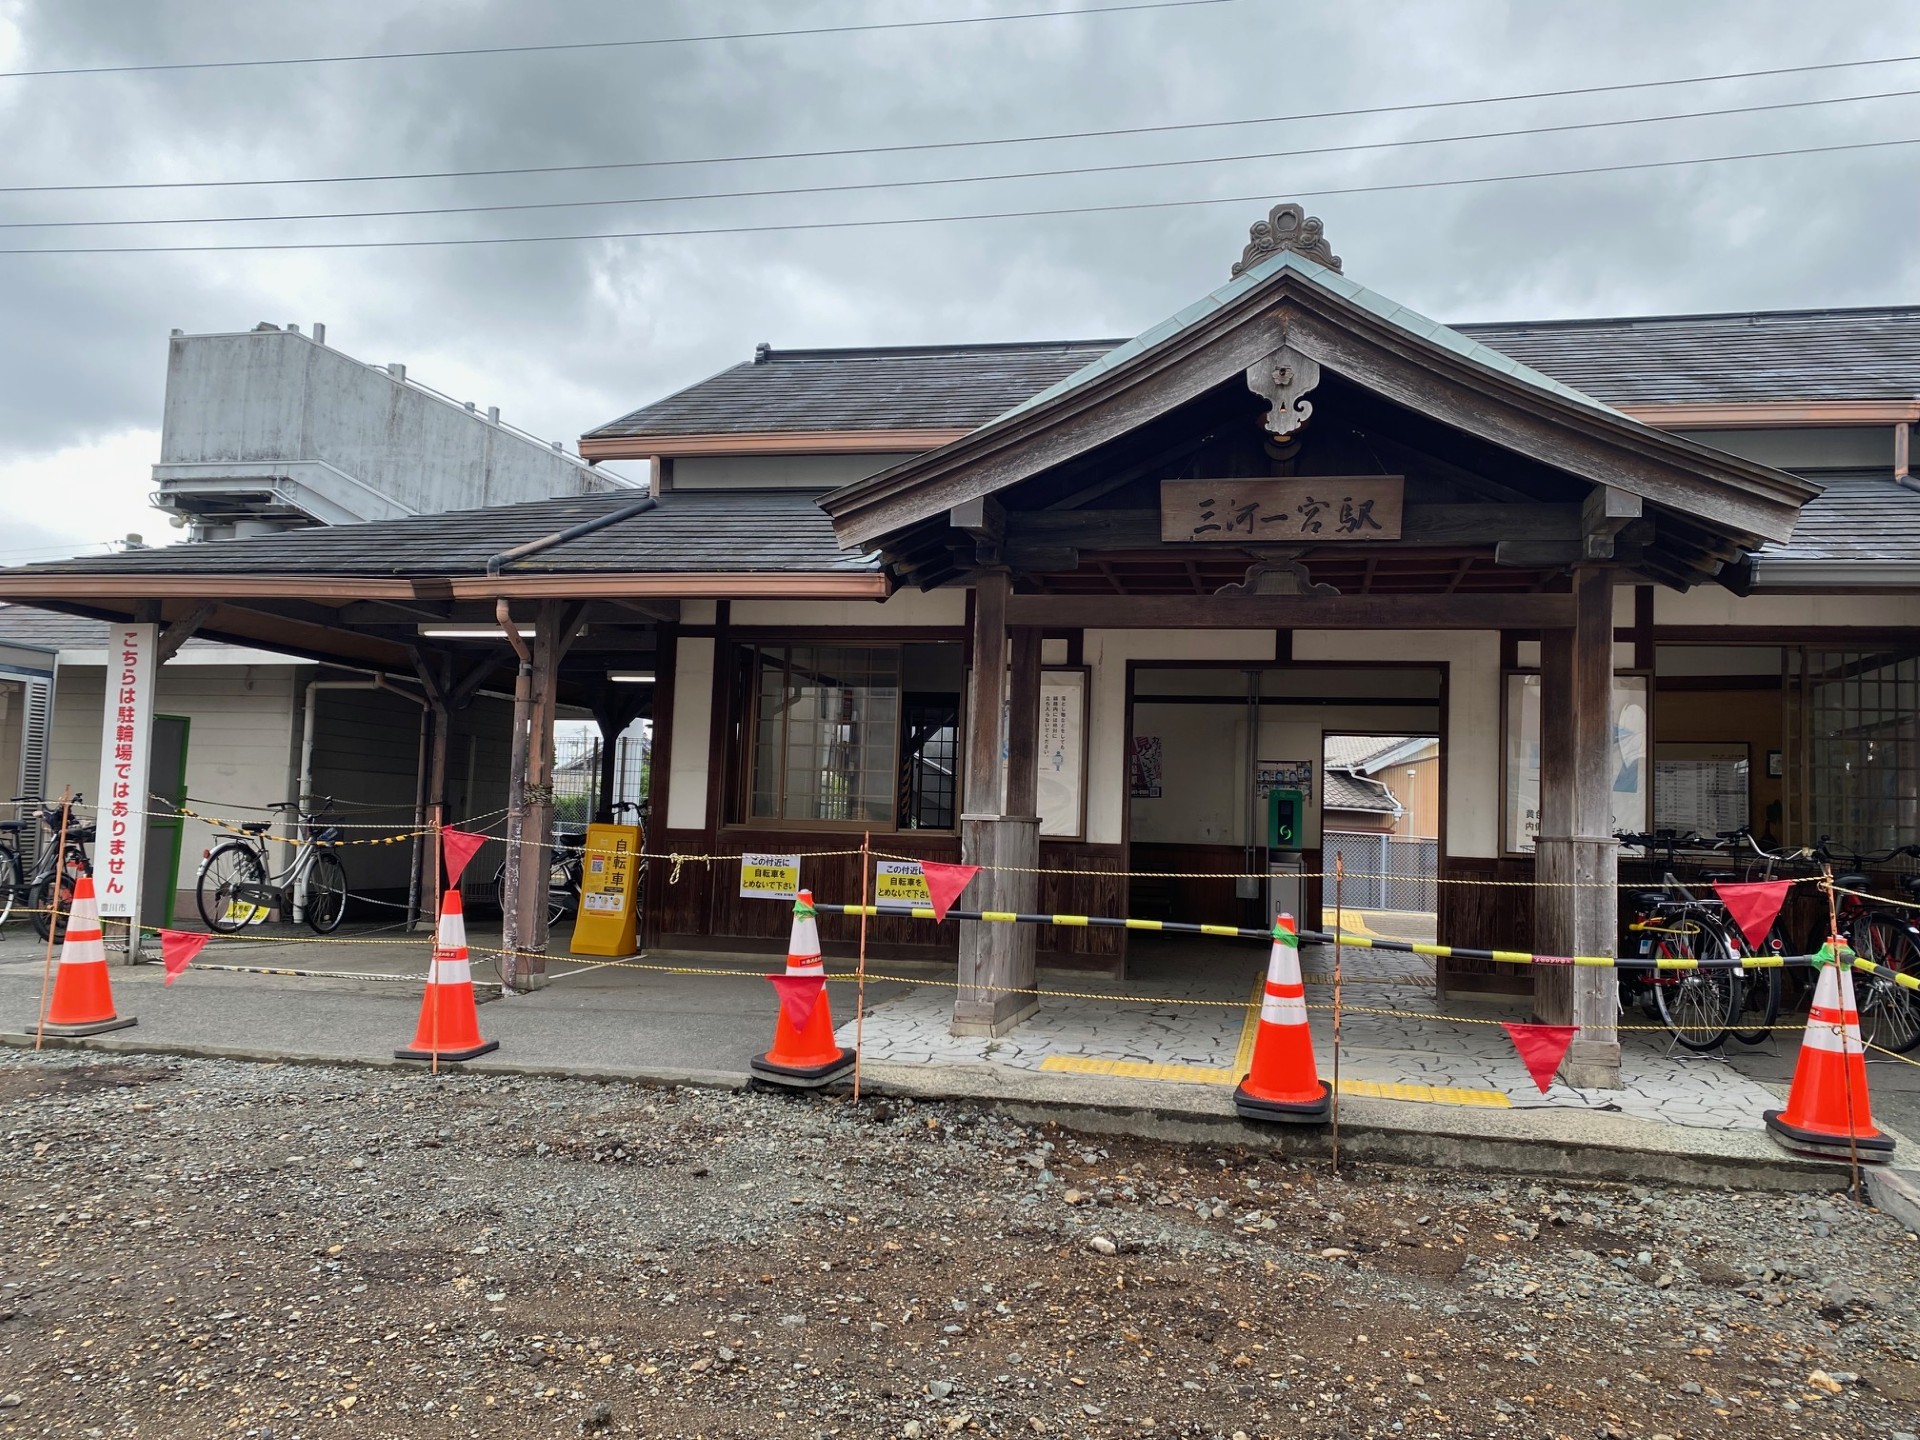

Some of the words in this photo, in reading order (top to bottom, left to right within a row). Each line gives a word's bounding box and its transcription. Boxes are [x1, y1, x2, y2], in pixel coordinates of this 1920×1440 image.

[1194, 496, 1382, 534] 三河一宮駅
[106, 632, 138, 894] こちらは駐輪場ではありません
[611, 839, 627, 886] 自転車
[751, 857, 790, 867] この付近に
[754, 869, 786, 878] 自転車を
[742, 880, 796, 890] とめないで下さい
[890, 877, 922, 887] 自転車を
